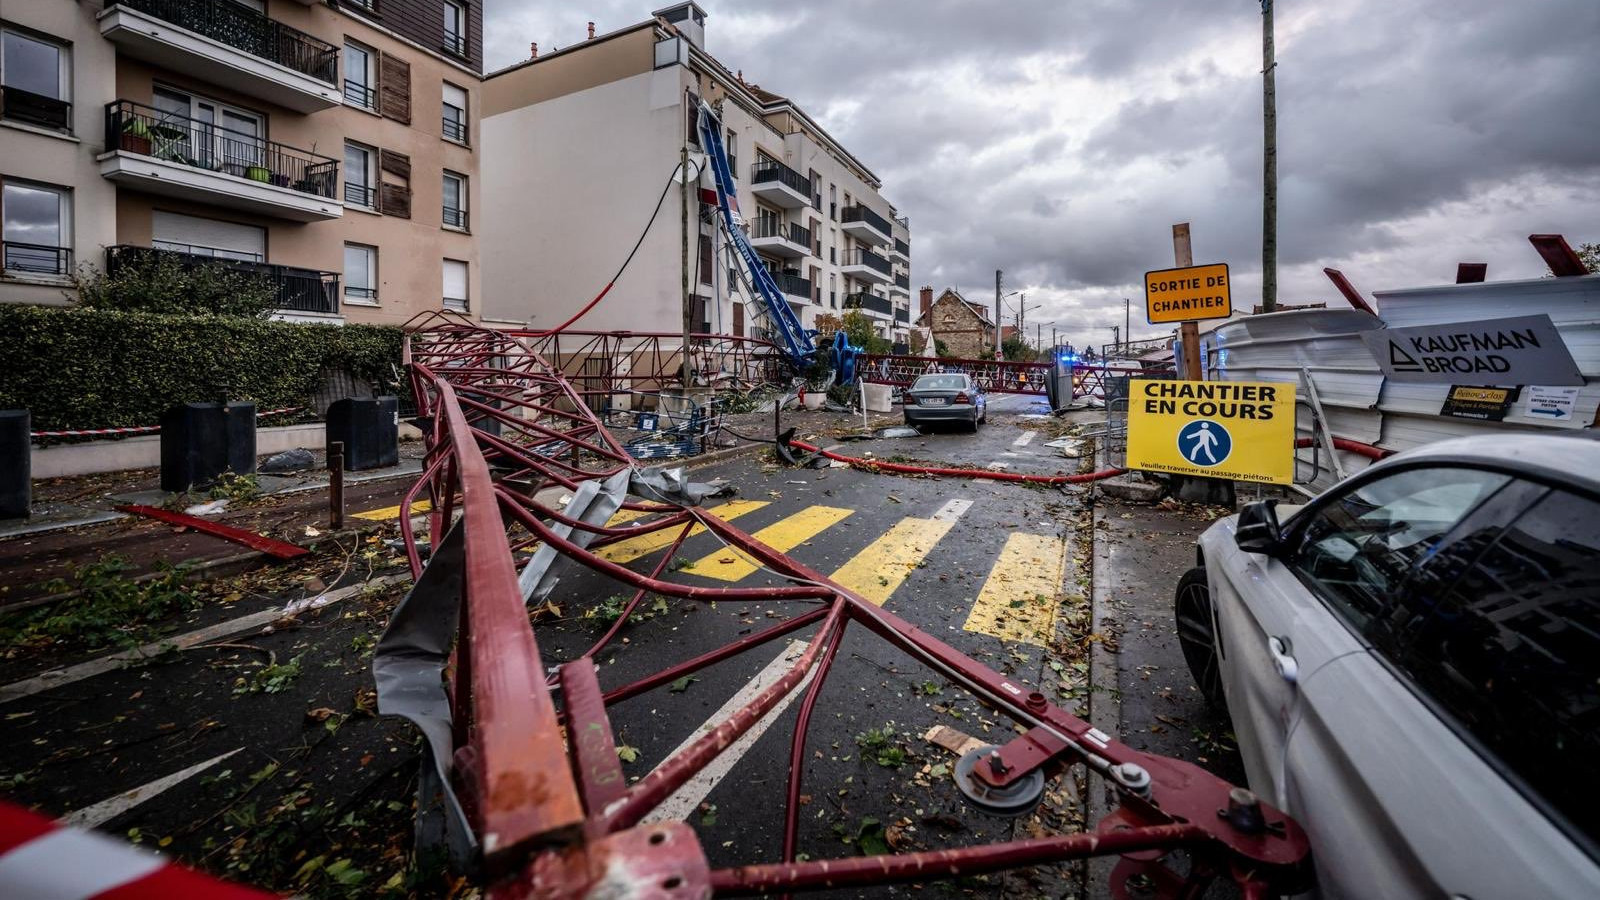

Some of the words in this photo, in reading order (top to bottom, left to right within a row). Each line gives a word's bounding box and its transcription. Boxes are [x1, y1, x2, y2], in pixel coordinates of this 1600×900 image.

[1150, 278, 1200, 293] SORTIE
[1206, 276, 1226, 288] DE
[1153, 296, 1224, 313] CHANTIER
[1409, 328, 1541, 353] KAUFMAN
[1421, 355, 1511, 373] BROAD
[1144, 383, 1276, 402] CHANTIER
[1145, 400, 1176, 414] EN
[1183, 401, 1273, 420] COURS
[1140, 461, 1166, 470] Veuillez
[1167, 464, 1199, 474] traverser
[1211, 470, 1242, 479] passage
[1243, 472, 1274, 482] piétons
